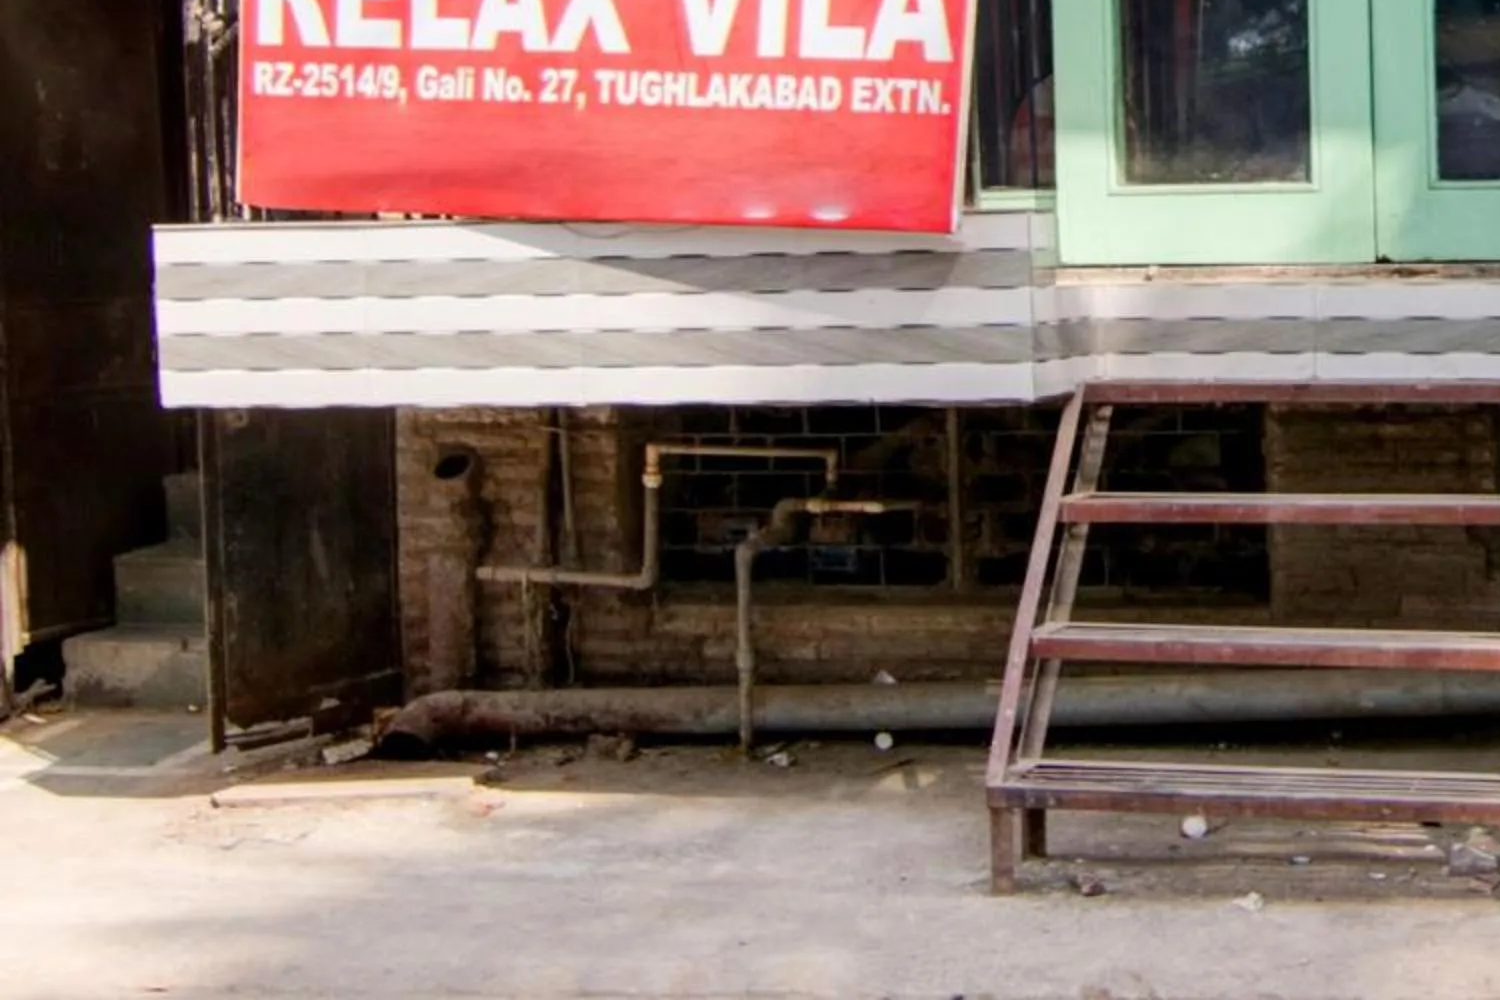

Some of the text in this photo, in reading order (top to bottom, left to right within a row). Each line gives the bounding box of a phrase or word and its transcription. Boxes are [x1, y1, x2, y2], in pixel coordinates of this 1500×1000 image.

[253, 61, 951, 115] RZ-2514/9, Gali No. 27, TUGHLAKABAD EXTN.
